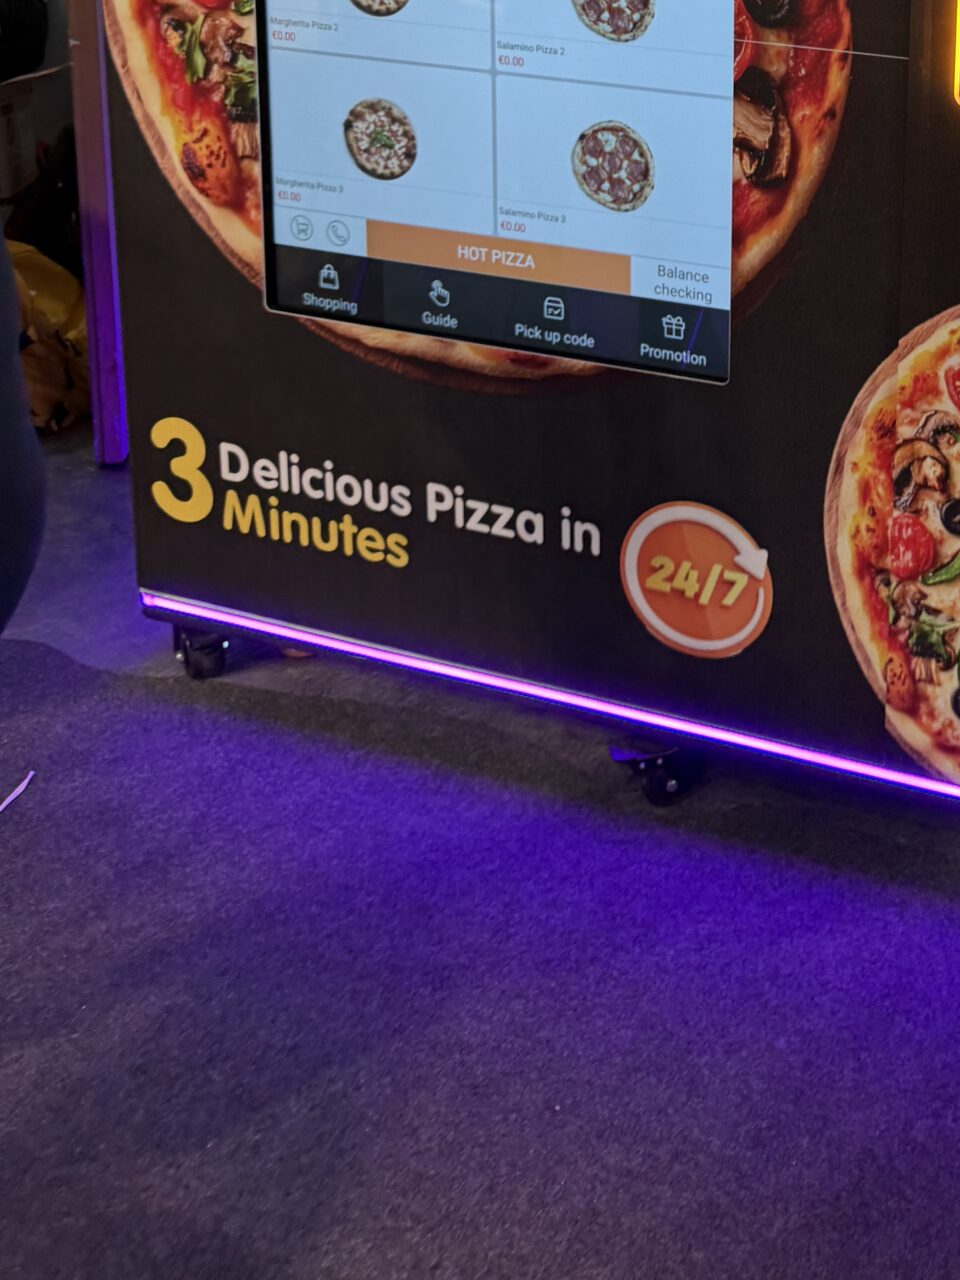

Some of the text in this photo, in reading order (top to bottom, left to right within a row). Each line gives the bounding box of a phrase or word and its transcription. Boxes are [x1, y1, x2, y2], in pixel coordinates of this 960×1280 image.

[311, 21, 333, 31] Pizza
[496, 40, 566, 56] Salamino Pizza 2
[498, 55, 525, 67] €0.00
[316, 182, 337, 193] Pizza
[499, 206, 536, 220] Salamino
[537, 211, 560, 223] Pizza
[500, 220, 526, 233] €0.00
[456, 244, 536, 269] HOT PIZZA
[657, 264, 710, 284] Balance
[302, 291, 358, 315] Shopping
[654, 284, 713, 305] checking
[421, 311, 458, 329] Guide
[514, 322, 595, 349] Pick up code
[640, 342, 707, 366] Promotion
[150, 416, 602, 557] 3 Delicious Pizza in
[222, 488, 410, 568] Minutes
[645, 555, 749, 607] 24/7
